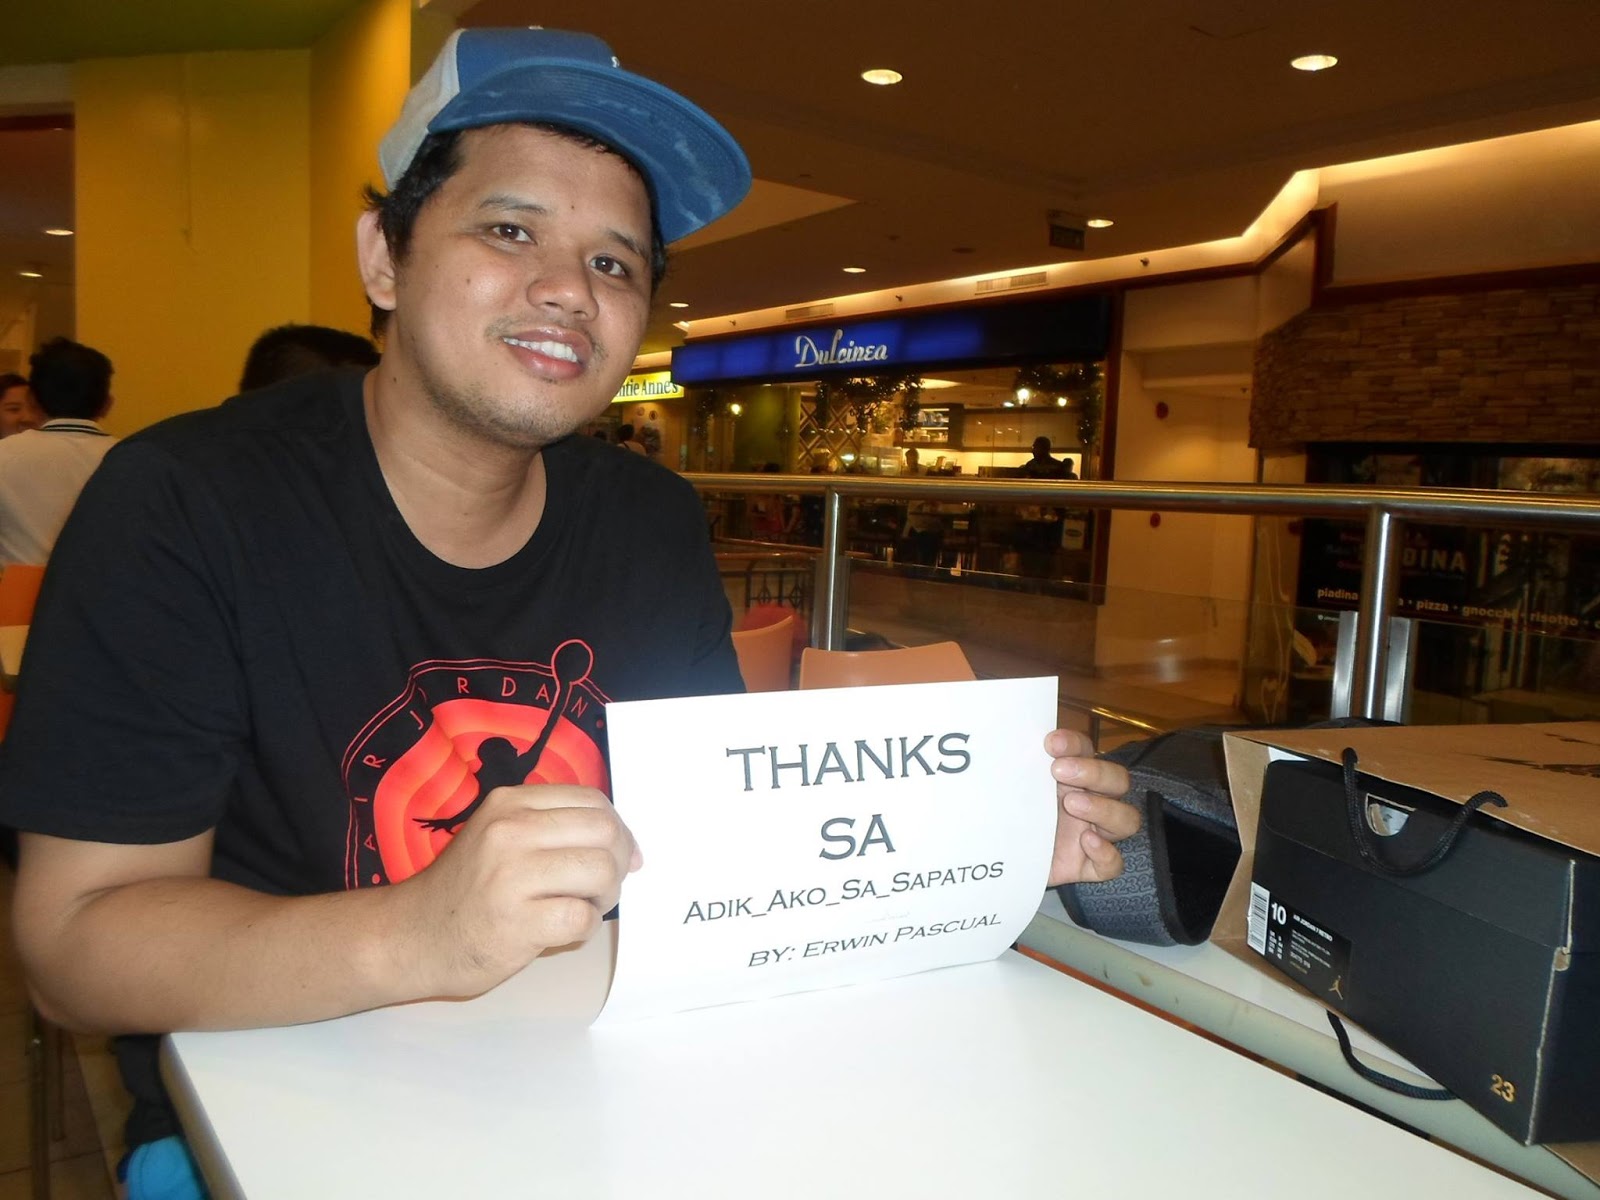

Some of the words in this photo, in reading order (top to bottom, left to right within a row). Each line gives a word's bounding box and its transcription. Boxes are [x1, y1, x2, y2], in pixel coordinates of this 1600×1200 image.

[794, 328, 889, 368] Dulcinea
[618, 379, 640, 397] ntie
[641, 378, 679, 396] Anne's
[1402, 547, 1468, 573] DINA
[1317, 587, 1359, 601] piadina
[1415, 598, 1450, 613] pizza
[1530, 612, 1579, 626] risotto
[409, 676, 588, 731] JRDAN
[726, 732, 971, 792] THANKS
[819, 813, 896, 860] SA
[1271, 902, 1287, 925] 10
[748, 946, 797, 967] BY:
[802, 931, 888, 959] ERWIN
[893, 913, 1002, 943] PASCUAL
[1490, 1074, 1516, 1102] 23
